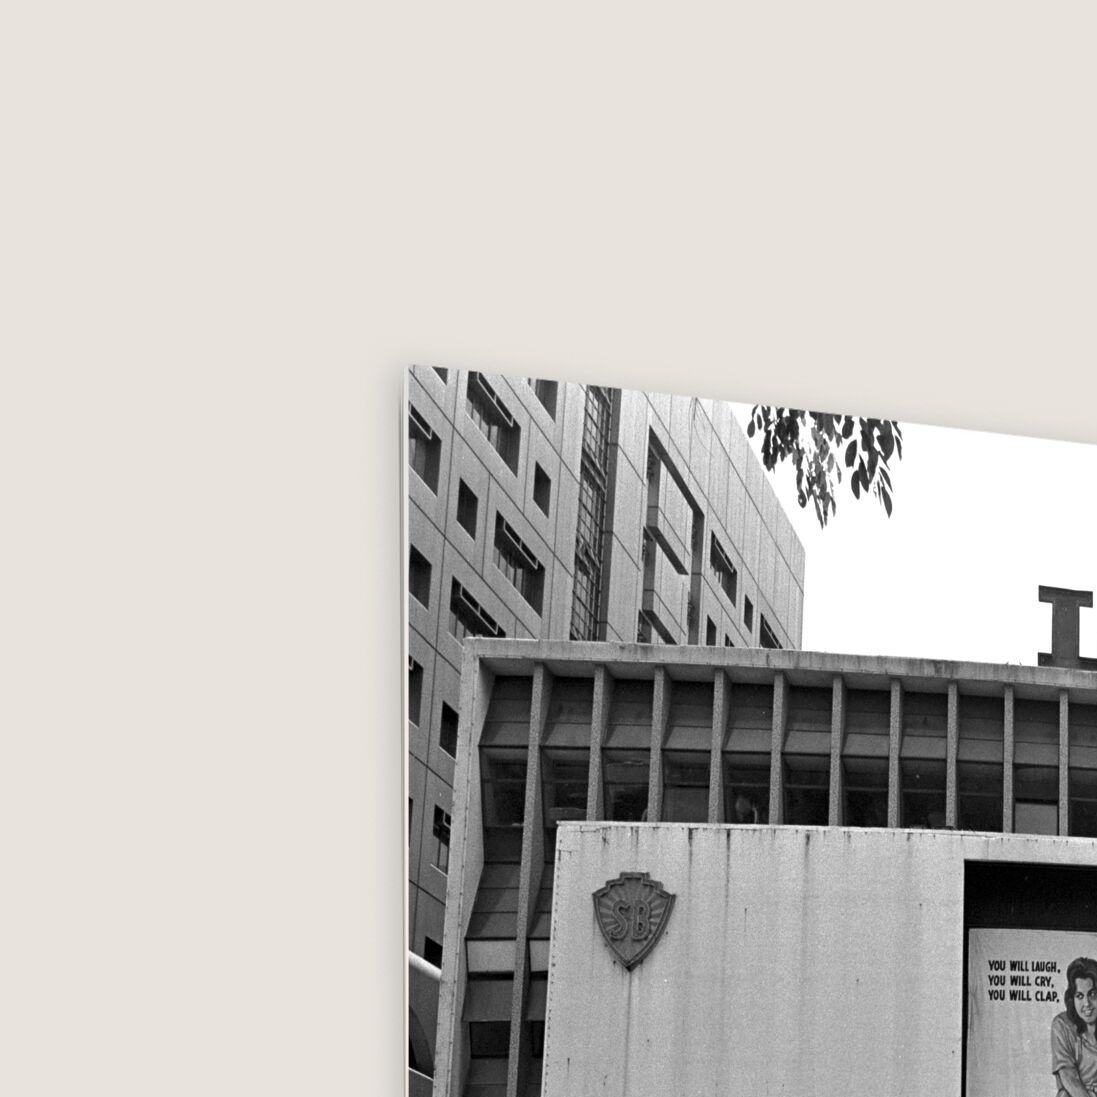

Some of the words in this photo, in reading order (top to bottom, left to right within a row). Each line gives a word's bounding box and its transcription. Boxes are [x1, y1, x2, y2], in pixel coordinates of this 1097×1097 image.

[611, 900, 651, 941] SB
[988, 960, 1006, 972] YOU
[1010, 960, 1029, 972] WILL
[988, 975, 1006, 987] YOU
[1010, 975, 1031, 987] WILL
[1035, 976, 1054, 988] CRY,
[988, 989, 1006, 1001] YOU
[1010, 990, 1031, 1001] WILL
